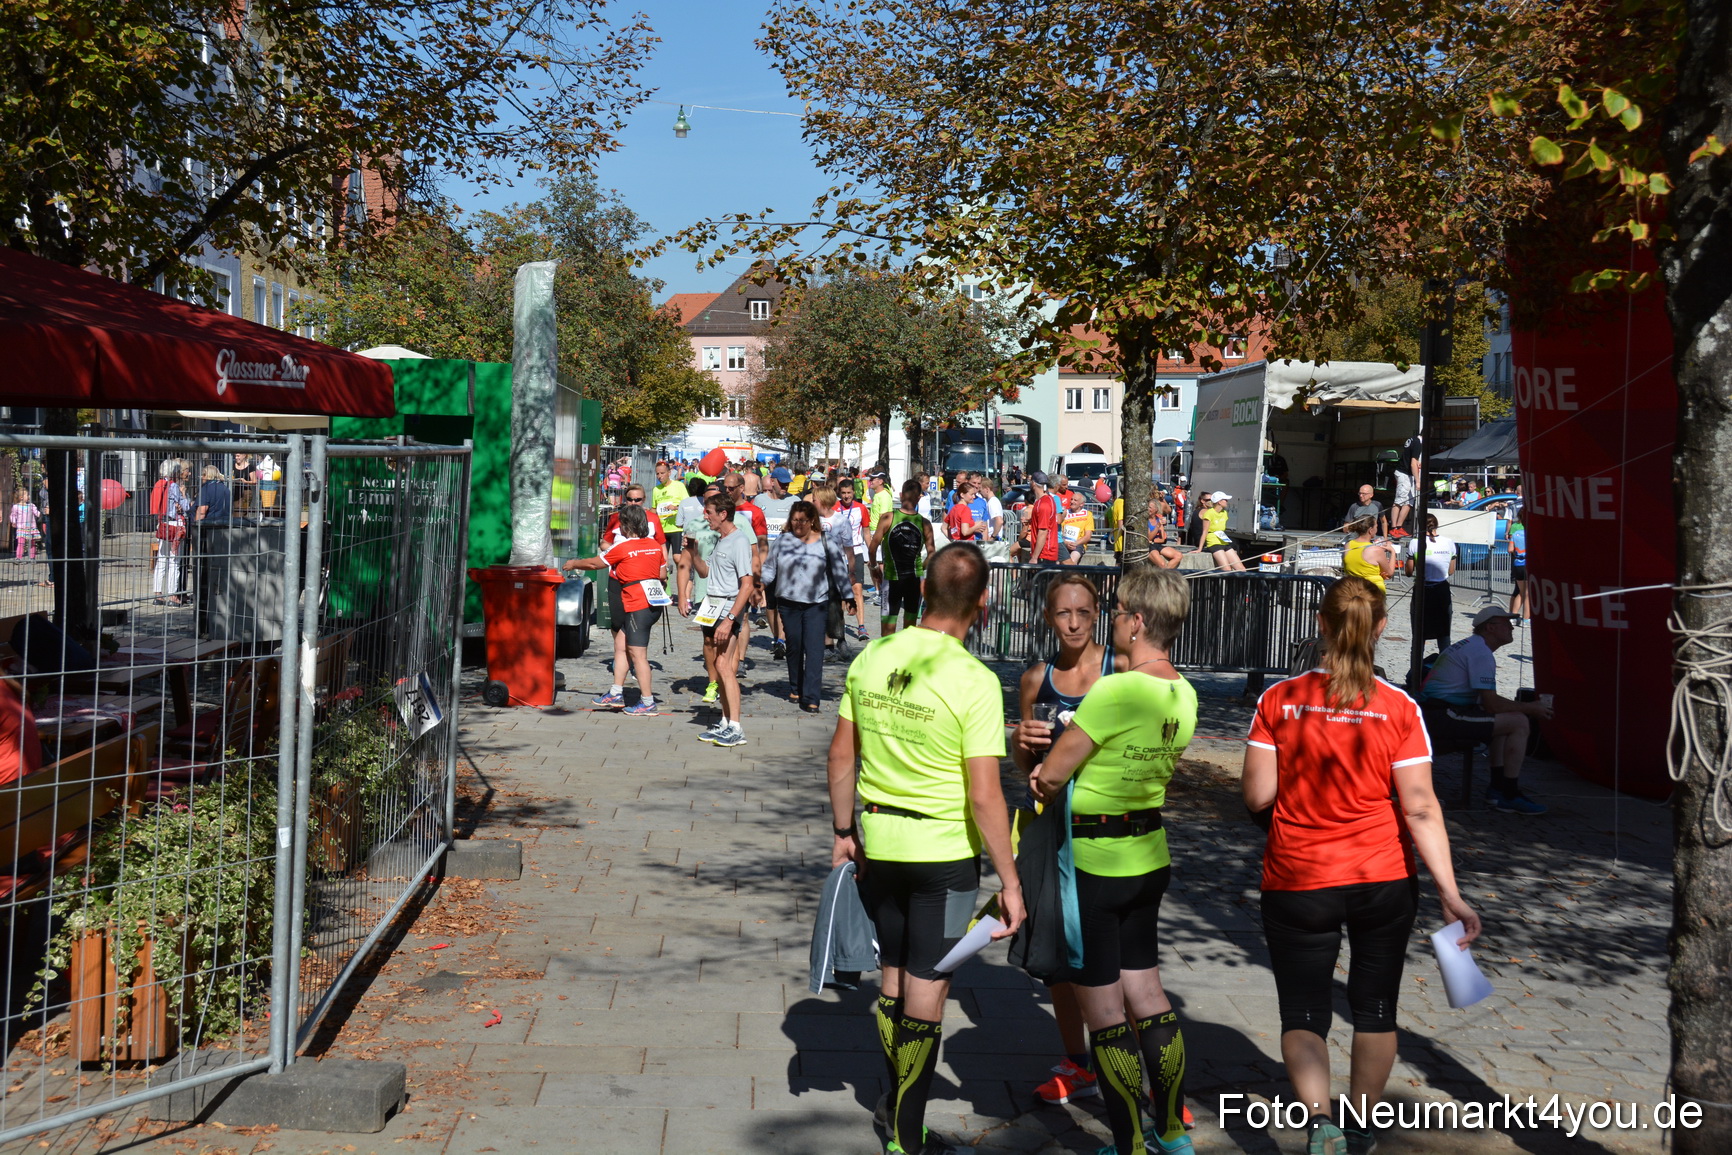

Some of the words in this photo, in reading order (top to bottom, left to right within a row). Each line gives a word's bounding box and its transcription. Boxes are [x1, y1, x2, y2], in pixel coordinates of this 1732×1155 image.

[216, 349, 310, 395] Glossner-Bier
[1233, 400, 1259, 424] BOCK
[362, 476, 438, 490] Neumakter
[628, 550, 638, 558] TV
[707, 604, 717, 614] 77
[858, 689, 867, 698] SC
[1282, 704, 1304, 720] TV
[1304, 705, 1388, 721] Sulzbac-Rosenberg
[1326, 714, 1363, 724] Lauftreff
[1125, 744, 1141, 752] SC
[878, 996, 896, 1007] ep
[901, 1018, 929, 1032] cep
[1136, 1019, 1152, 1030] ep
[1159, 1012, 1177, 1024] ce
[1097, 1026, 1127, 1041] cep
